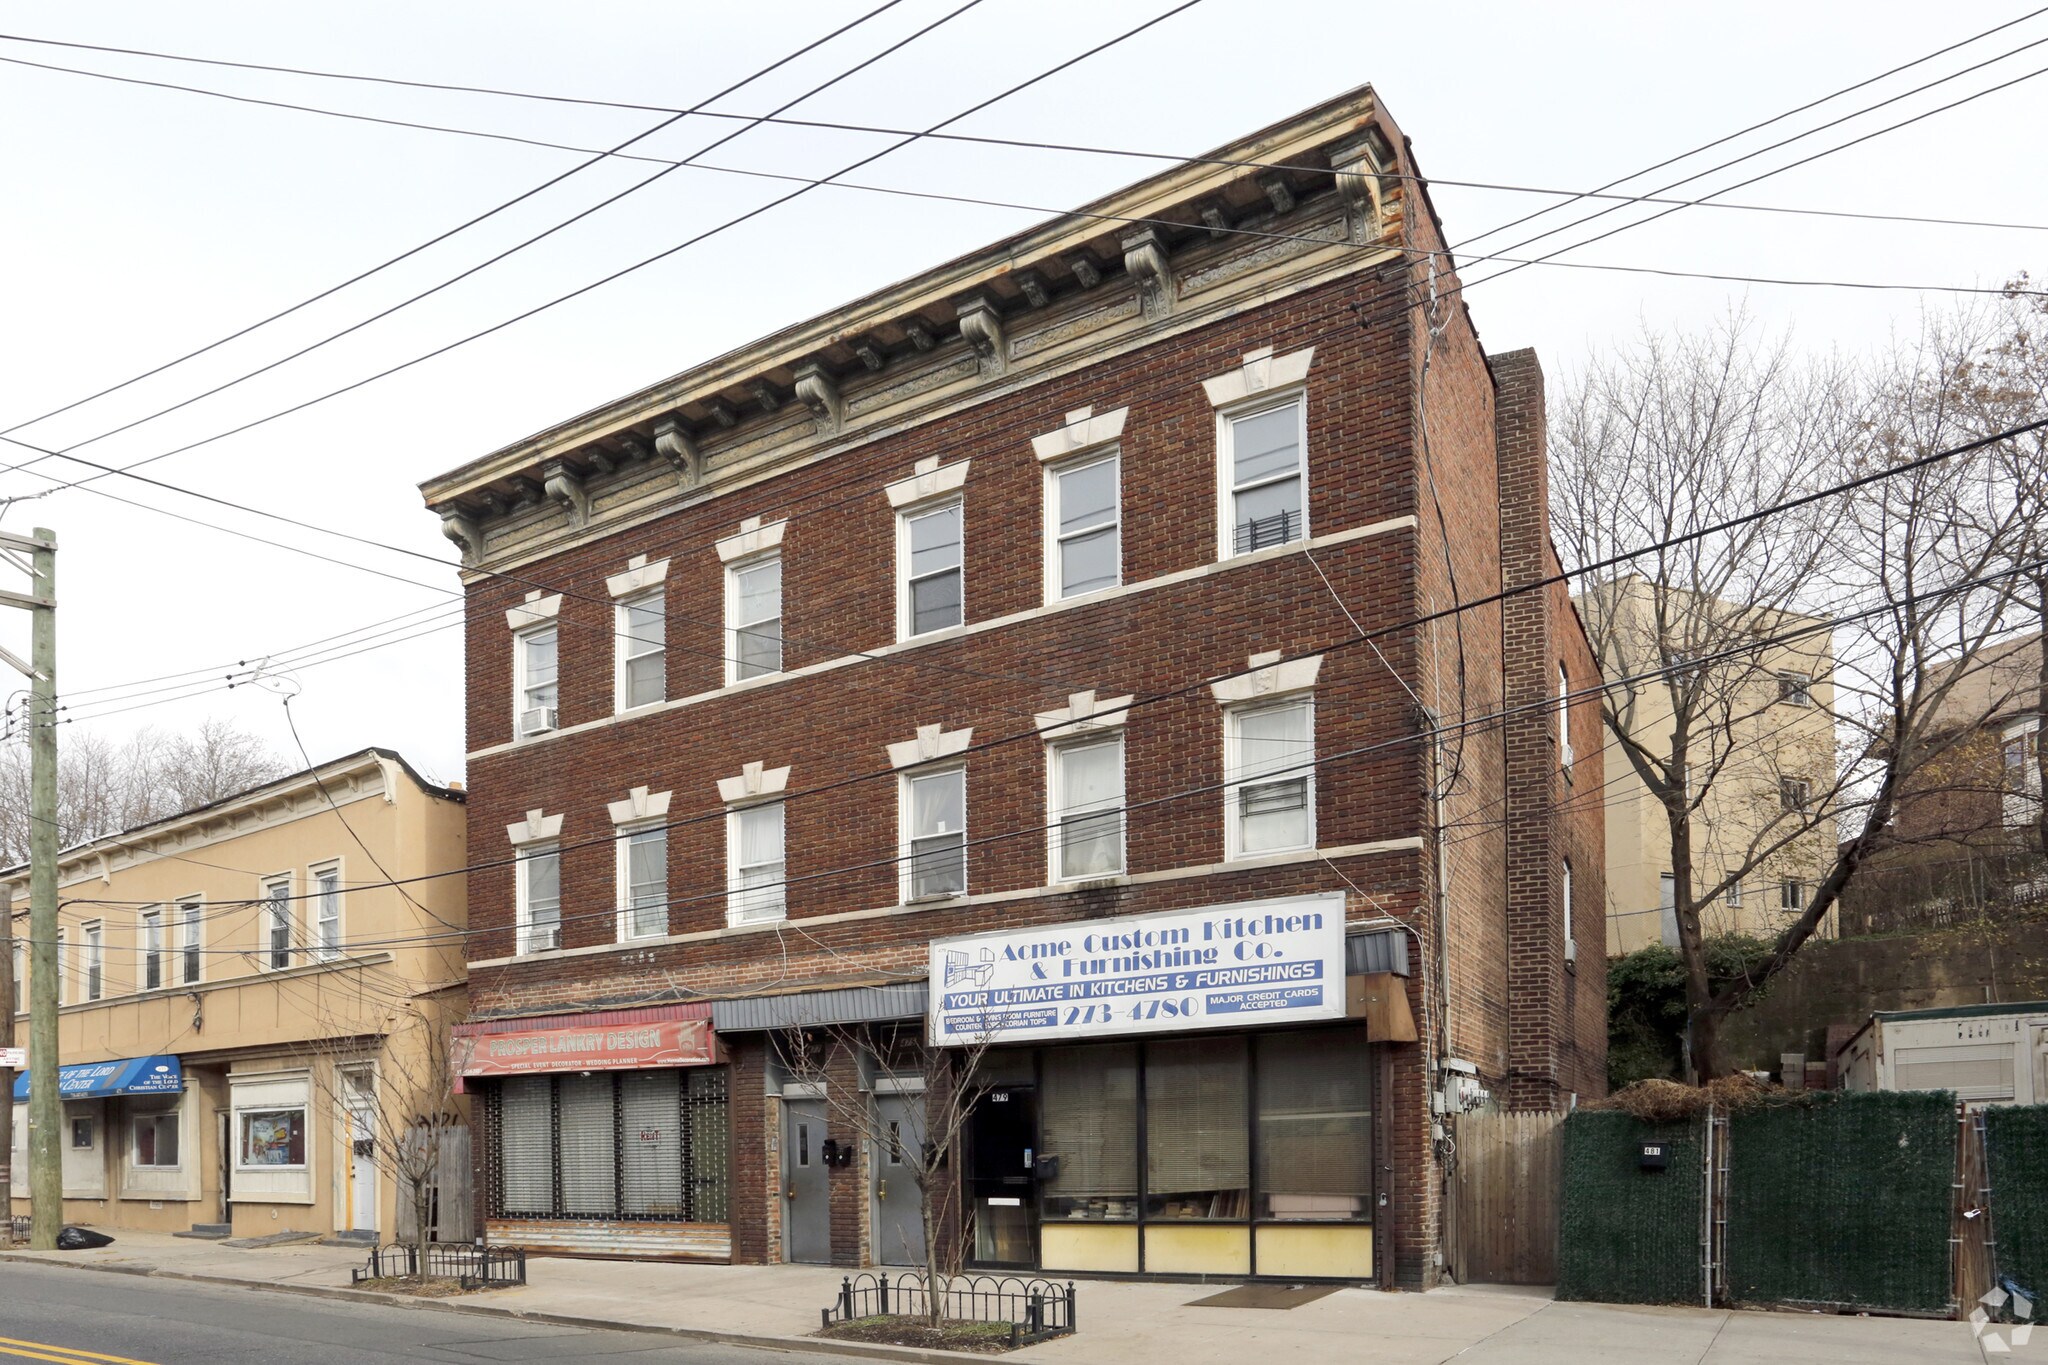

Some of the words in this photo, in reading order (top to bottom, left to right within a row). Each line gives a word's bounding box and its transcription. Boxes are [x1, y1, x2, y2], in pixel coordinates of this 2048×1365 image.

[999, 944, 1071, 962] Acme
[1084, 928, 1189, 953] Custom
[1203, 913, 1322, 941] Kitchen
[1030, 961, 1048, 980] &
[1063, 946, 1218, 977] Furnishing
[1234, 940, 1283, 961] Co.
[950, 992, 988, 1008] YOUR
[995, 986, 1063, 1004] ULTIMATE
[1069, 983, 1085, 998] IN
[1090, 976, 1168, 996] KITCHENS
[1175, 974, 1189, 989] &
[1195, 963, 1315, 987] FURNISHINGS
[1210, 995, 1243, 1004] MAJOR
[1247, 992, 1281, 1001] CREDIT
[1284, 988, 1319, 998] CARDS
[1064, 997, 1199, 1025] 273-4780
[1240, 1000, 1288, 1010] ACCEPTED
[1023, 1009, 1056, 1018] FURNITURE
[955, 1022, 982, 1030] COUNTER
[1030, 1018, 1047, 1026] TOPS
[489, 1037, 547, 1056] PROSPER
[550, 1033, 604, 1053] LANKRY
[607, 1029, 661, 1050] DESIGN
[552, 1060, 582, 1068] DECORATOR
[992, 1093, 1008, 1102] 479
